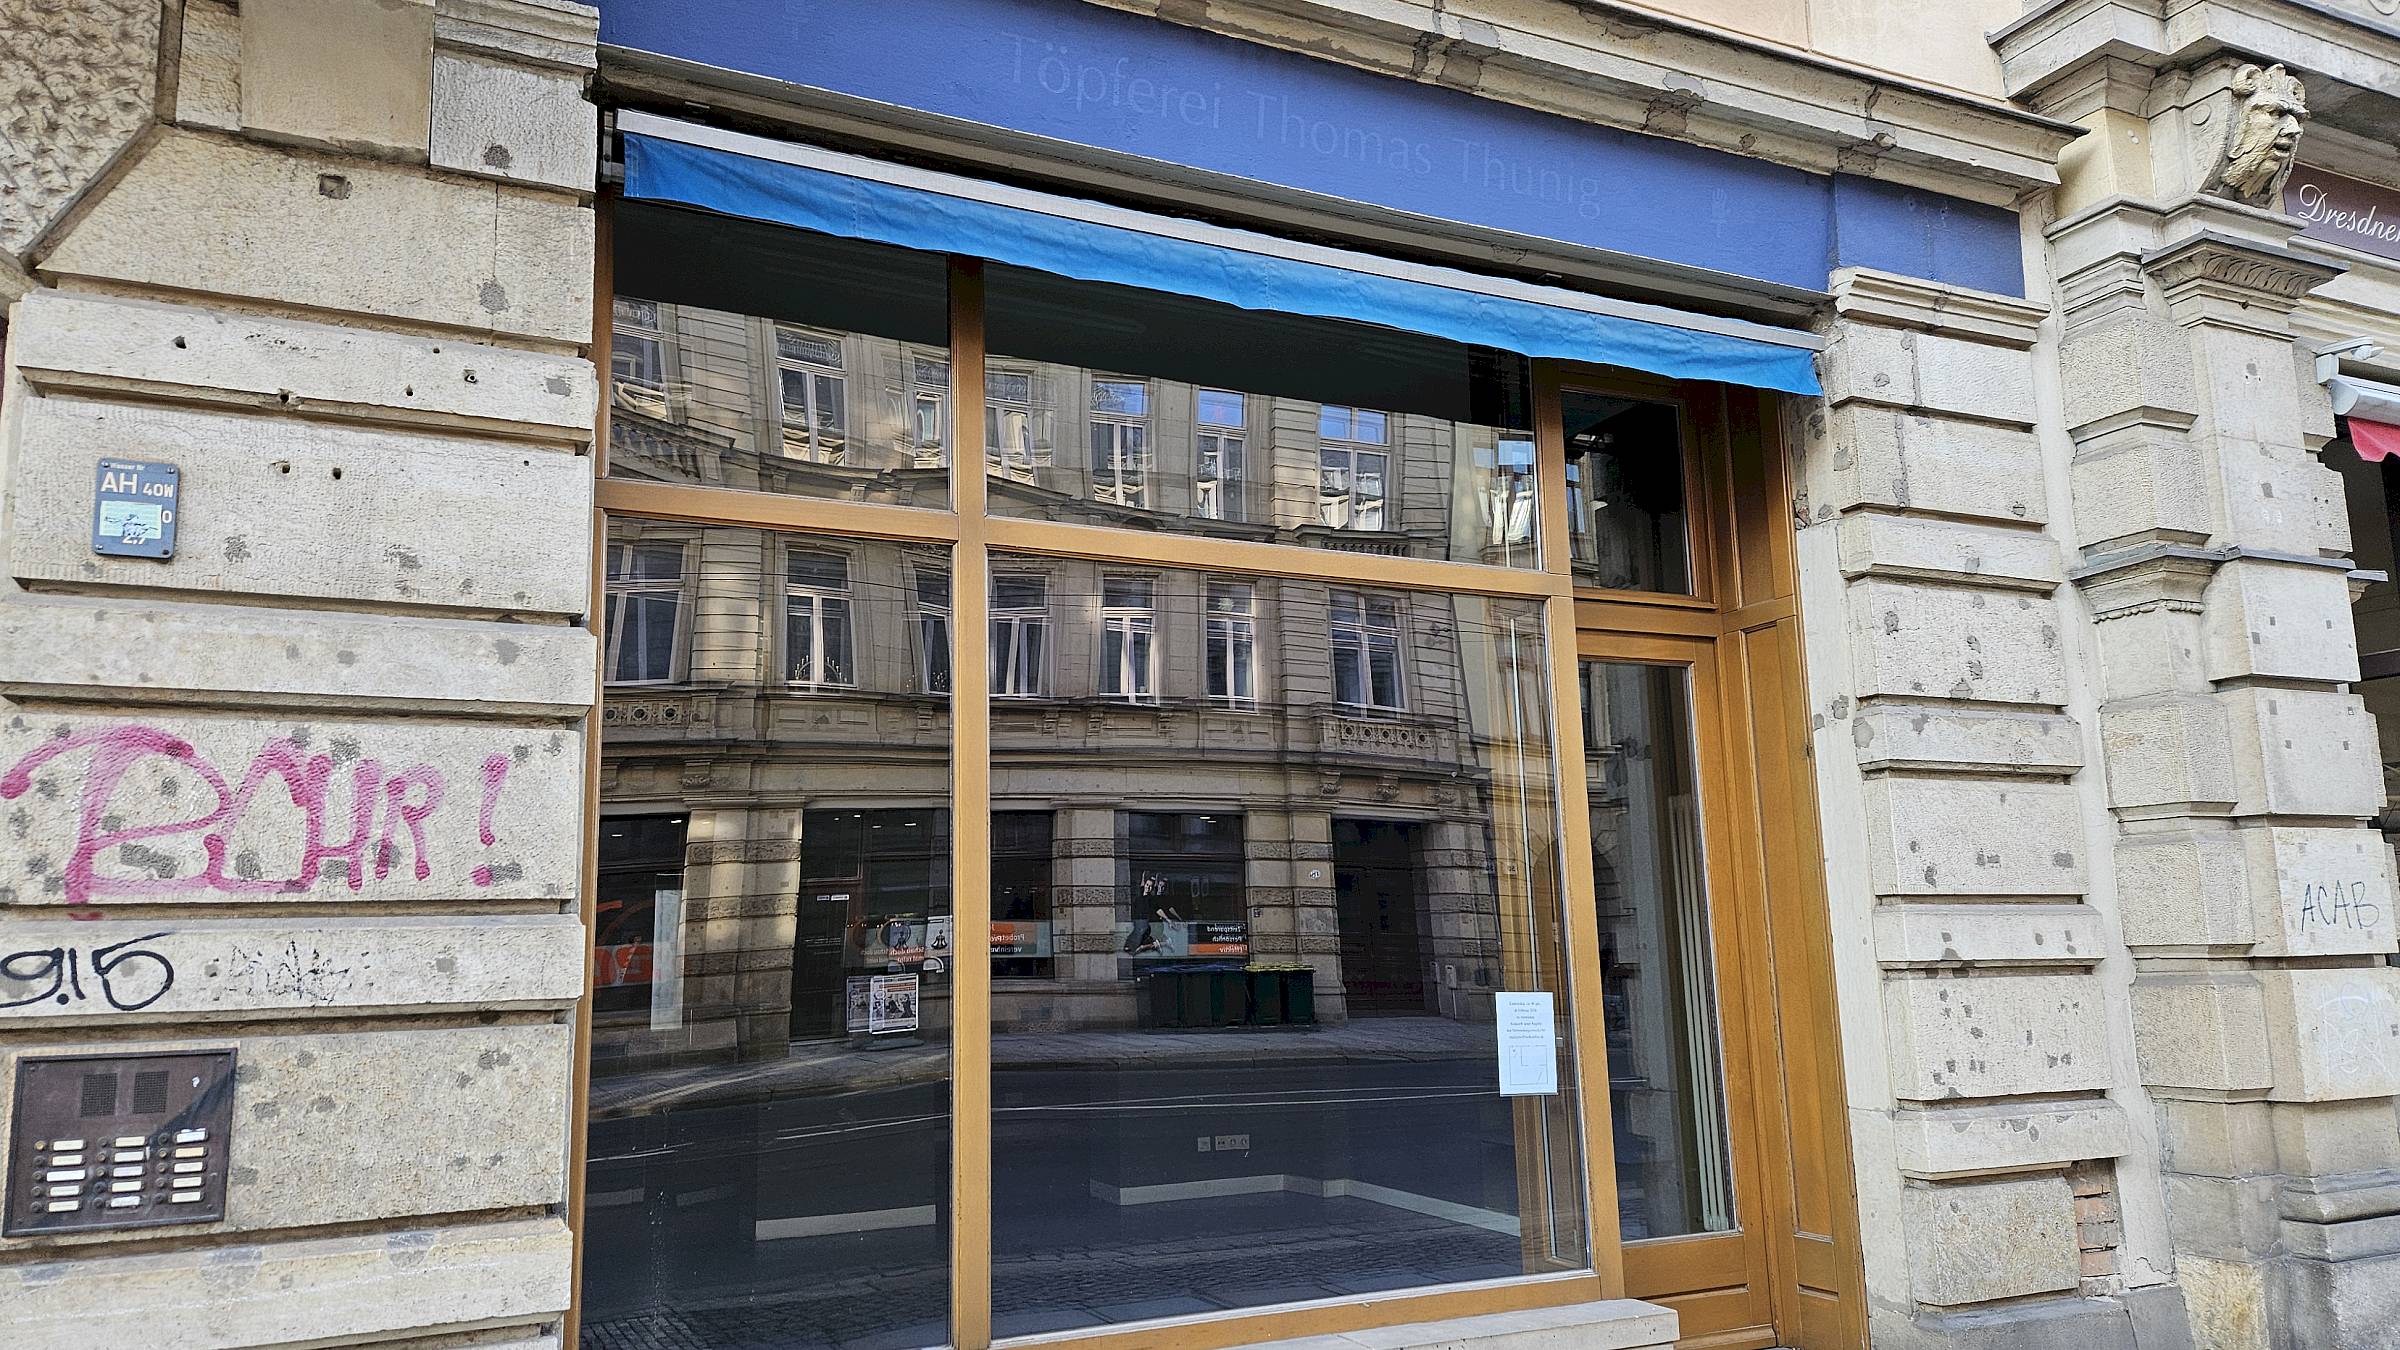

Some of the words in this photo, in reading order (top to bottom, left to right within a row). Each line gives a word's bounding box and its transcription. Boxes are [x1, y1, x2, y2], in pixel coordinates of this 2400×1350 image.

[1001, 31, 1222, 128] Töpferei
[1246, 90, 1433, 175] Thomas
[1453, 137, 1601, 220] Thunig
[101, 471, 138, 494] AH
[2301, 879, 2381, 932] ACAB
